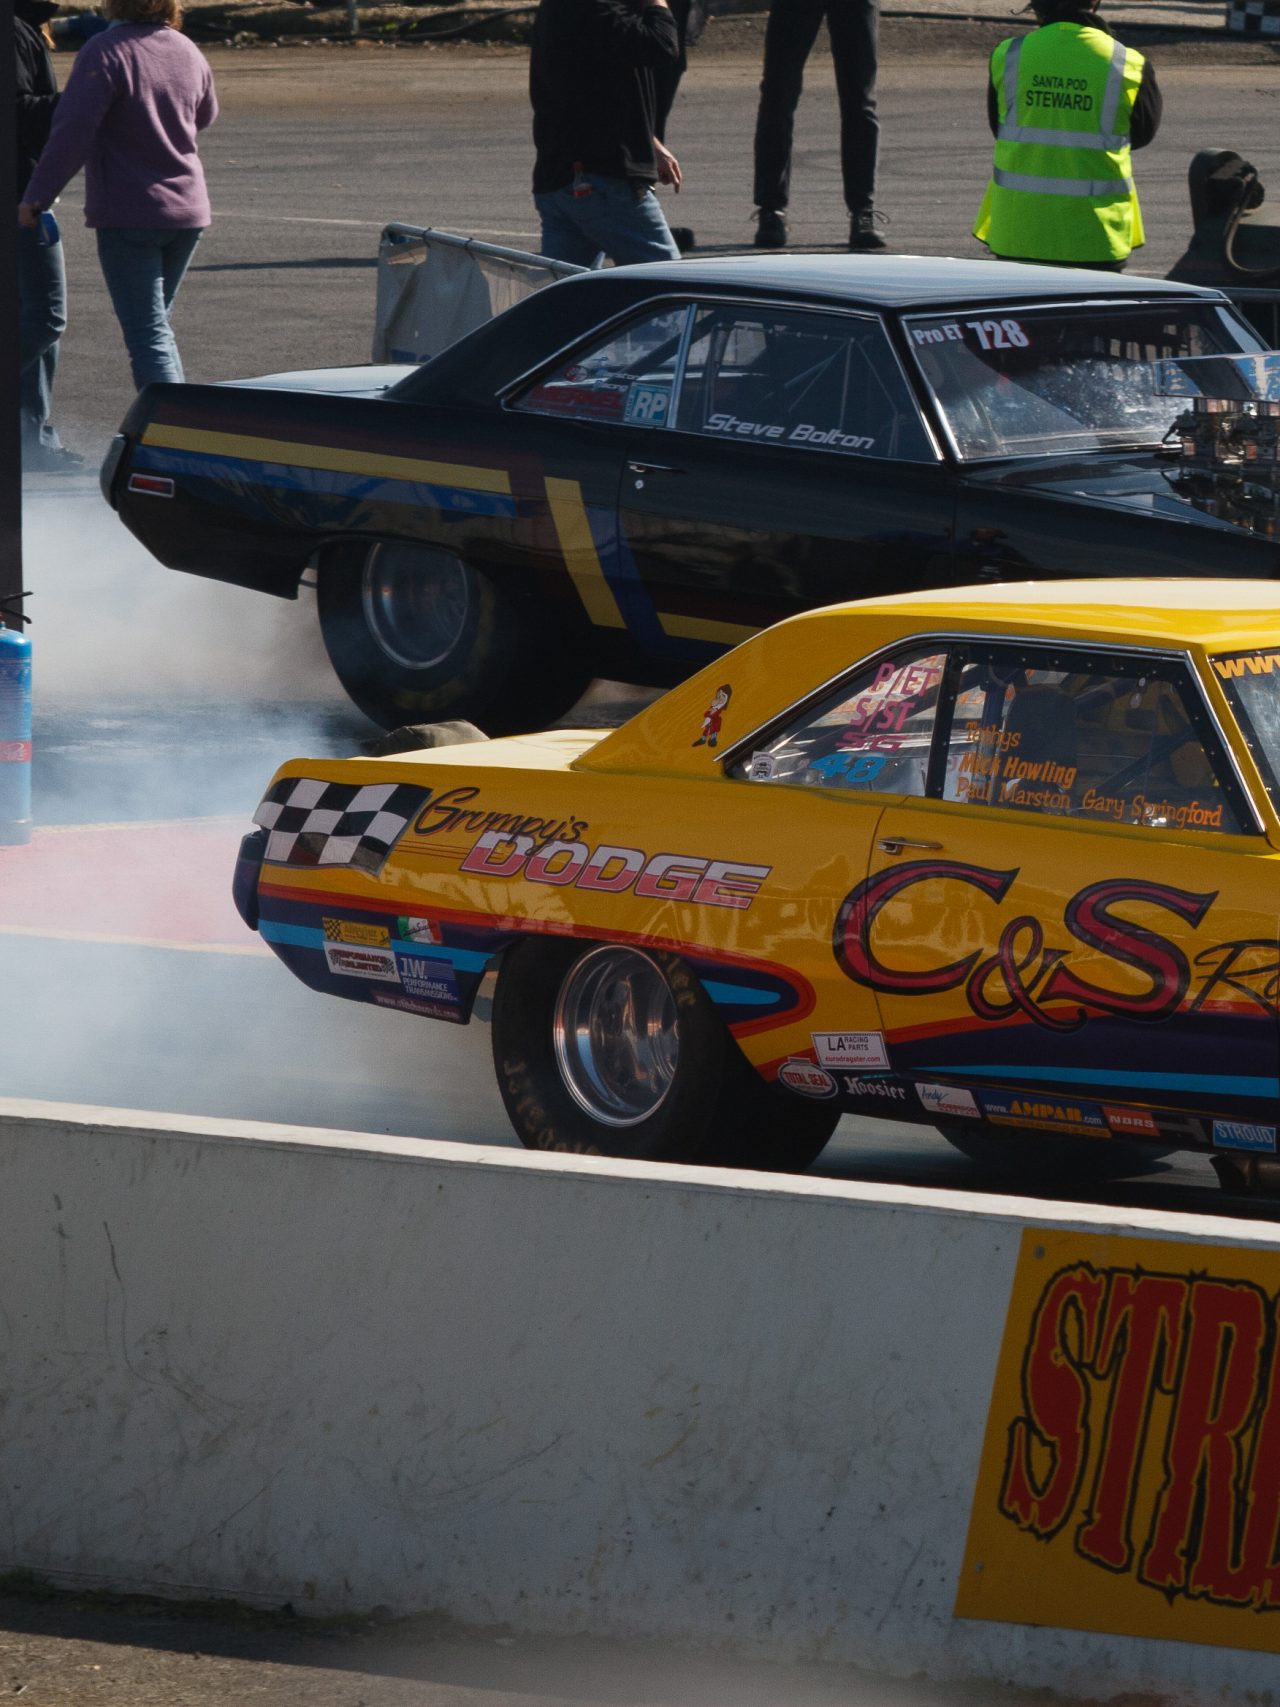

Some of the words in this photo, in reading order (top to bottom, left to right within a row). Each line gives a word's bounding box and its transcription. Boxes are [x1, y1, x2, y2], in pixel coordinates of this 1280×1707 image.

[1032, 74, 1065, 89] SANTA
[1066, 78, 1088, 91] POD
[1026, 91, 1093, 111] STEWARD
[912, 328, 944, 346] Pro
[946, 324, 964, 342] ET
[966, 319, 1030, 350] 728
[632, 390, 667, 419] RP
[704, 413, 786, 438] Steve
[788, 424, 876, 449] Bolton
[871, 662, 940, 699] P/ET
[849, 697, 916, 733] S/ST
[808, 752, 890, 783] 48
[959, 751, 999, 776] Mick
[1003, 756, 1078, 789] Howling
[955, 776, 992, 800] Paul
[1000, 782, 1072, 810] Marston
[1082, 788, 1126, 820] Gary
[1130, 795, 1224, 829] Springford
[413, 786, 589, 855] Grumpy's
[459, 828, 773, 911] DODGE
[833, 859, 1220, 1034] C&S
[400, 956, 428, 980] J.W.
[402, 978, 448, 991] PERFORMANCE
[828, 1037, 846, 1051] LA
[844, 1036, 869, 1044] RACING
[825, 1055, 881, 1063] eurodragster.com
[784, 1071, 807, 1085] TOTAL
[807, 1073, 831, 1087] SEAL
[844, 1076, 906, 1100] Hoosier
[921, 1085, 949, 1103] Andy
[1215, 1123, 1273, 1143] STROUD
